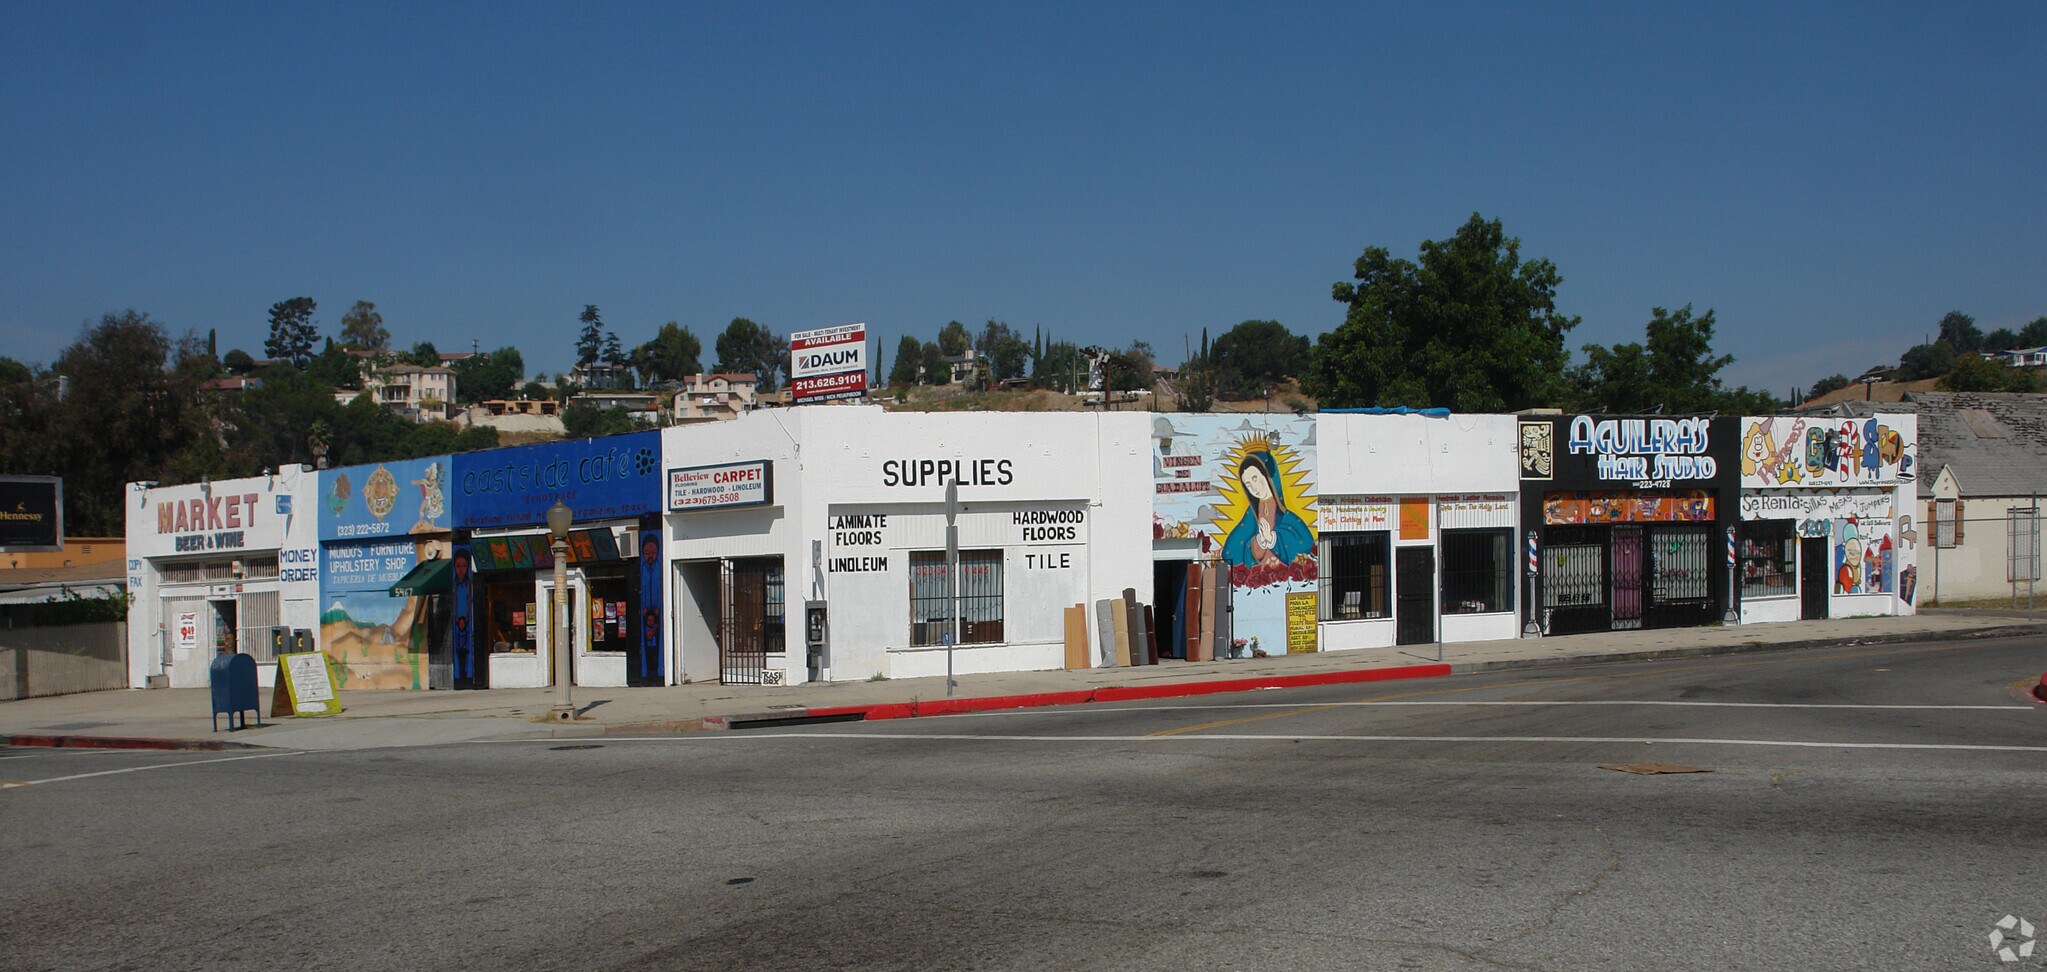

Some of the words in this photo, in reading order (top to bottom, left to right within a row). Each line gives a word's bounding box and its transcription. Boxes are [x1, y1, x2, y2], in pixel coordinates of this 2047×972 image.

[805, 333, 852, 346] AVAILABLE
[811, 349, 858, 368] DAUM
[796, 374, 862, 390] 213.626.9101
[1162, 455, 1202, 468] VIRGEN
[1597, 454, 1649, 481] HAIR
[1652, 454, 1717, 481] STUDIO
[674, 471, 710, 483] Belleview
[713, 468, 762, 484] CARPET
[882, 459, 1013, 487] SUPPLIES
[1176, 470, 1189, 478] DE
[674, 489, 687, 497] TILE
[691, 486, 725, 496] HARDWOOD
[732, 482, 762, 492] LINOLEUM
[1156, 481, 1210, 494] GUADALUPE
[620, 503, 649, 514] space
[1743, 494, 1760, 512] Se
[1829, 494, 1853, 513] MESAS
[1859, 495, 1890, 513] JUMPERS
[0, 511, 43, 522] Hennessy
[157, 493, 259, 534] MARKET
[1013, 510, 1084, 525] HARDWOOD
[337, 524, 355, 537] (323)
[356, 522, 390, 535] 222-5872
[828, 514, 887, 530] LAMINATE
[175, 534, 205, 552] BEER
[206, 536, 213, 549] &
[213, 531, 245, 549] WINE
[836, 530, 882, 546] FLOORS
[1022, 526, 1076, 541] FLOORS
[280, 549, 317, 565] MONEY
[329, 544, 364, 560] MUNDO'S
[369, 542, 415, 557] FURNITURE
[128, 559, 143, 571] COPY
[329, 558, 380, 574] UPHOLSTERY
[385, 557, 407, 571] SHOP
[828, 556, 888, 573] LINOLEUM
[1025, 553, 1070, 569] TILE
[129, 576, 143, 588] FAX
[280, 567, 318, 583] ORDER
[367, 573, 376, 583] DE
[394, 587, 414, 598] 5467
[763, 677, 779, 685] BOX
